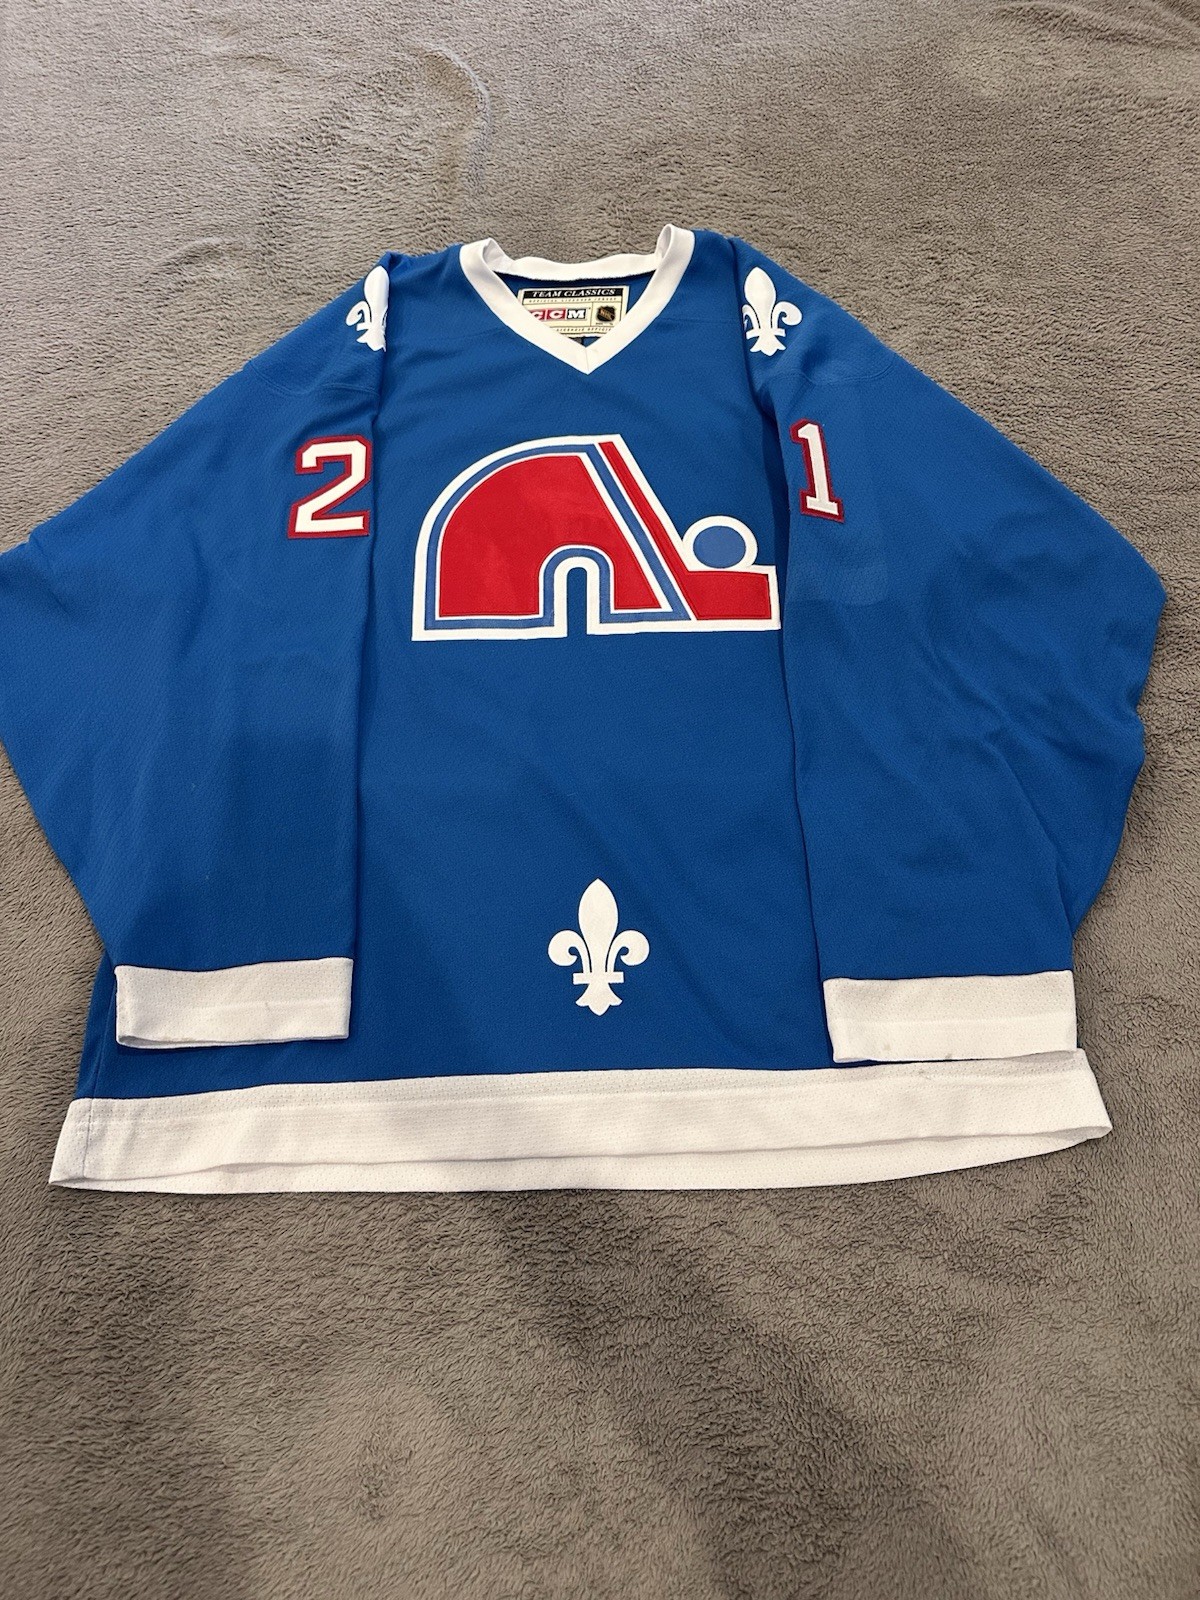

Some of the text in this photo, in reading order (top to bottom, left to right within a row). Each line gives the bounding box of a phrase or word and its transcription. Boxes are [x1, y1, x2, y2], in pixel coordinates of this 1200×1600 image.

[530, 309, 586, 319] CCM
[563, 288, 616, 297] CLASSICS
[287, 434, 373, 539] 2
[790, 418, 844, 522] 1
